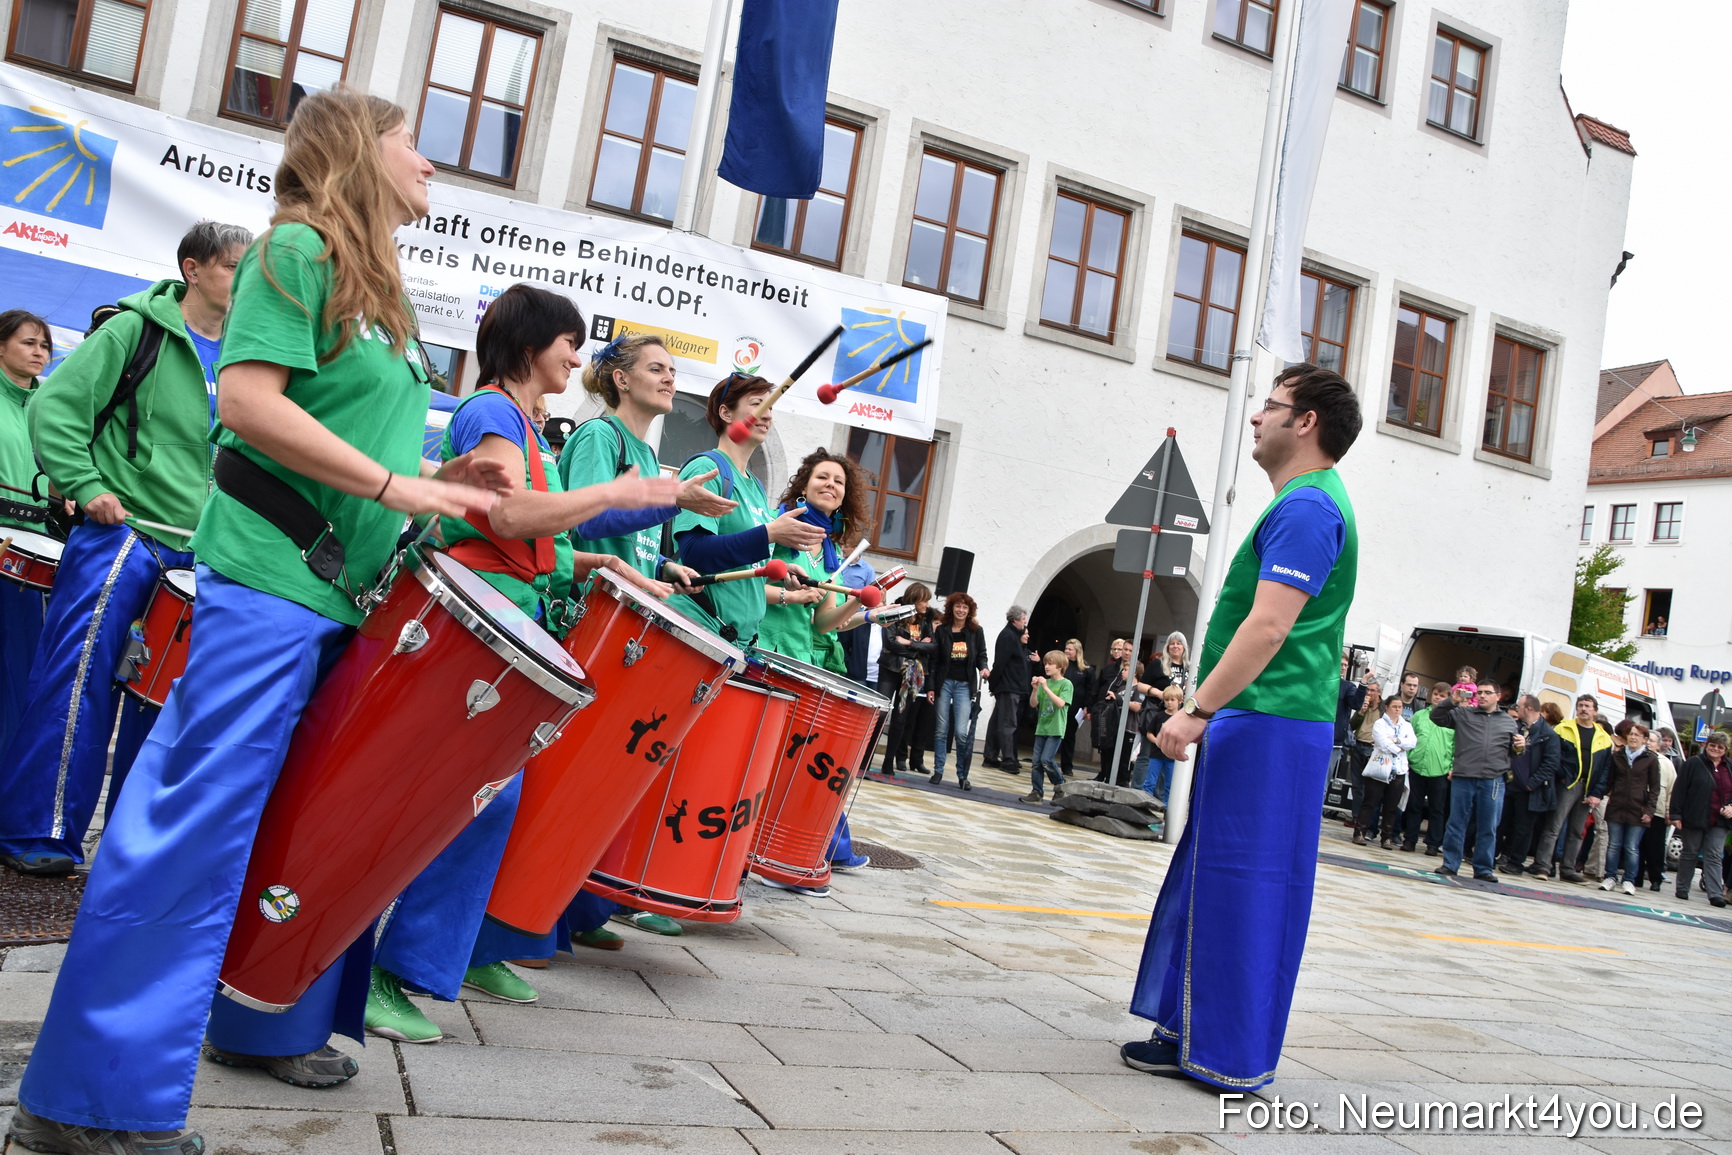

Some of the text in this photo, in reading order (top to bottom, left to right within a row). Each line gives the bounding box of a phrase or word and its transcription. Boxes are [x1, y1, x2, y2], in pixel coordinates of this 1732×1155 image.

[480, 224, 567, 256] offene
[578, 239, 809, 308] Behindertenarbeit
[472, 253, 605, 294] Neumarkt
[614, 275, 708, 316] i.d.OPf.
[404, 287, 461, 305] ozialstation
[665, 333, 710, 355] Wagner
[1271, 564, 1311, 582] REGENSBURG
